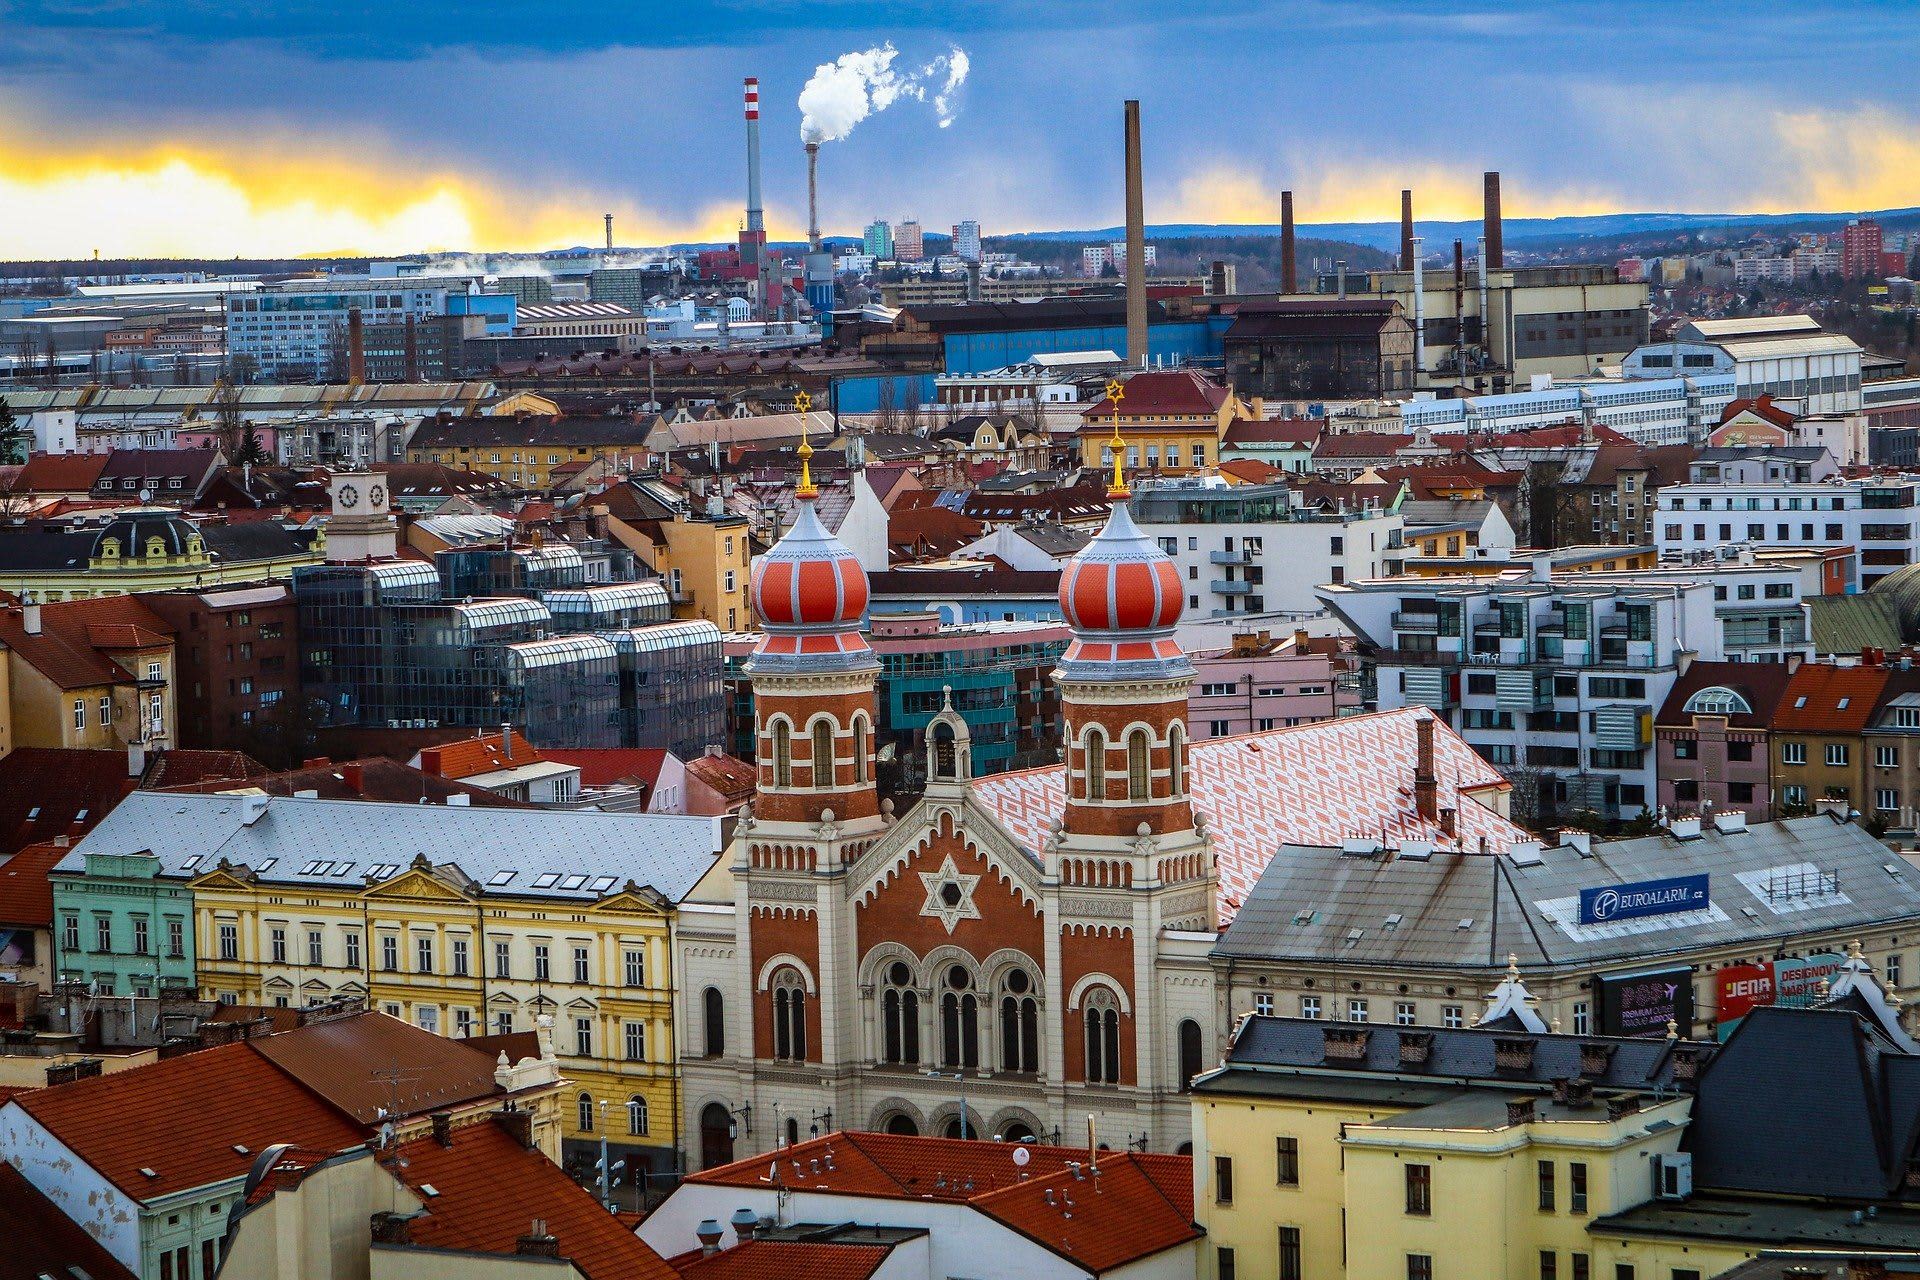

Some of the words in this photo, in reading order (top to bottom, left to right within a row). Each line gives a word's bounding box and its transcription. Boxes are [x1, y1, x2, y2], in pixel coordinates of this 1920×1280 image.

[1621, 888, 1688, 908] EUROALARM
[1726, 978, 1771, 998] JENA
[1781, 980, 1824, 996] NÁBYTE
